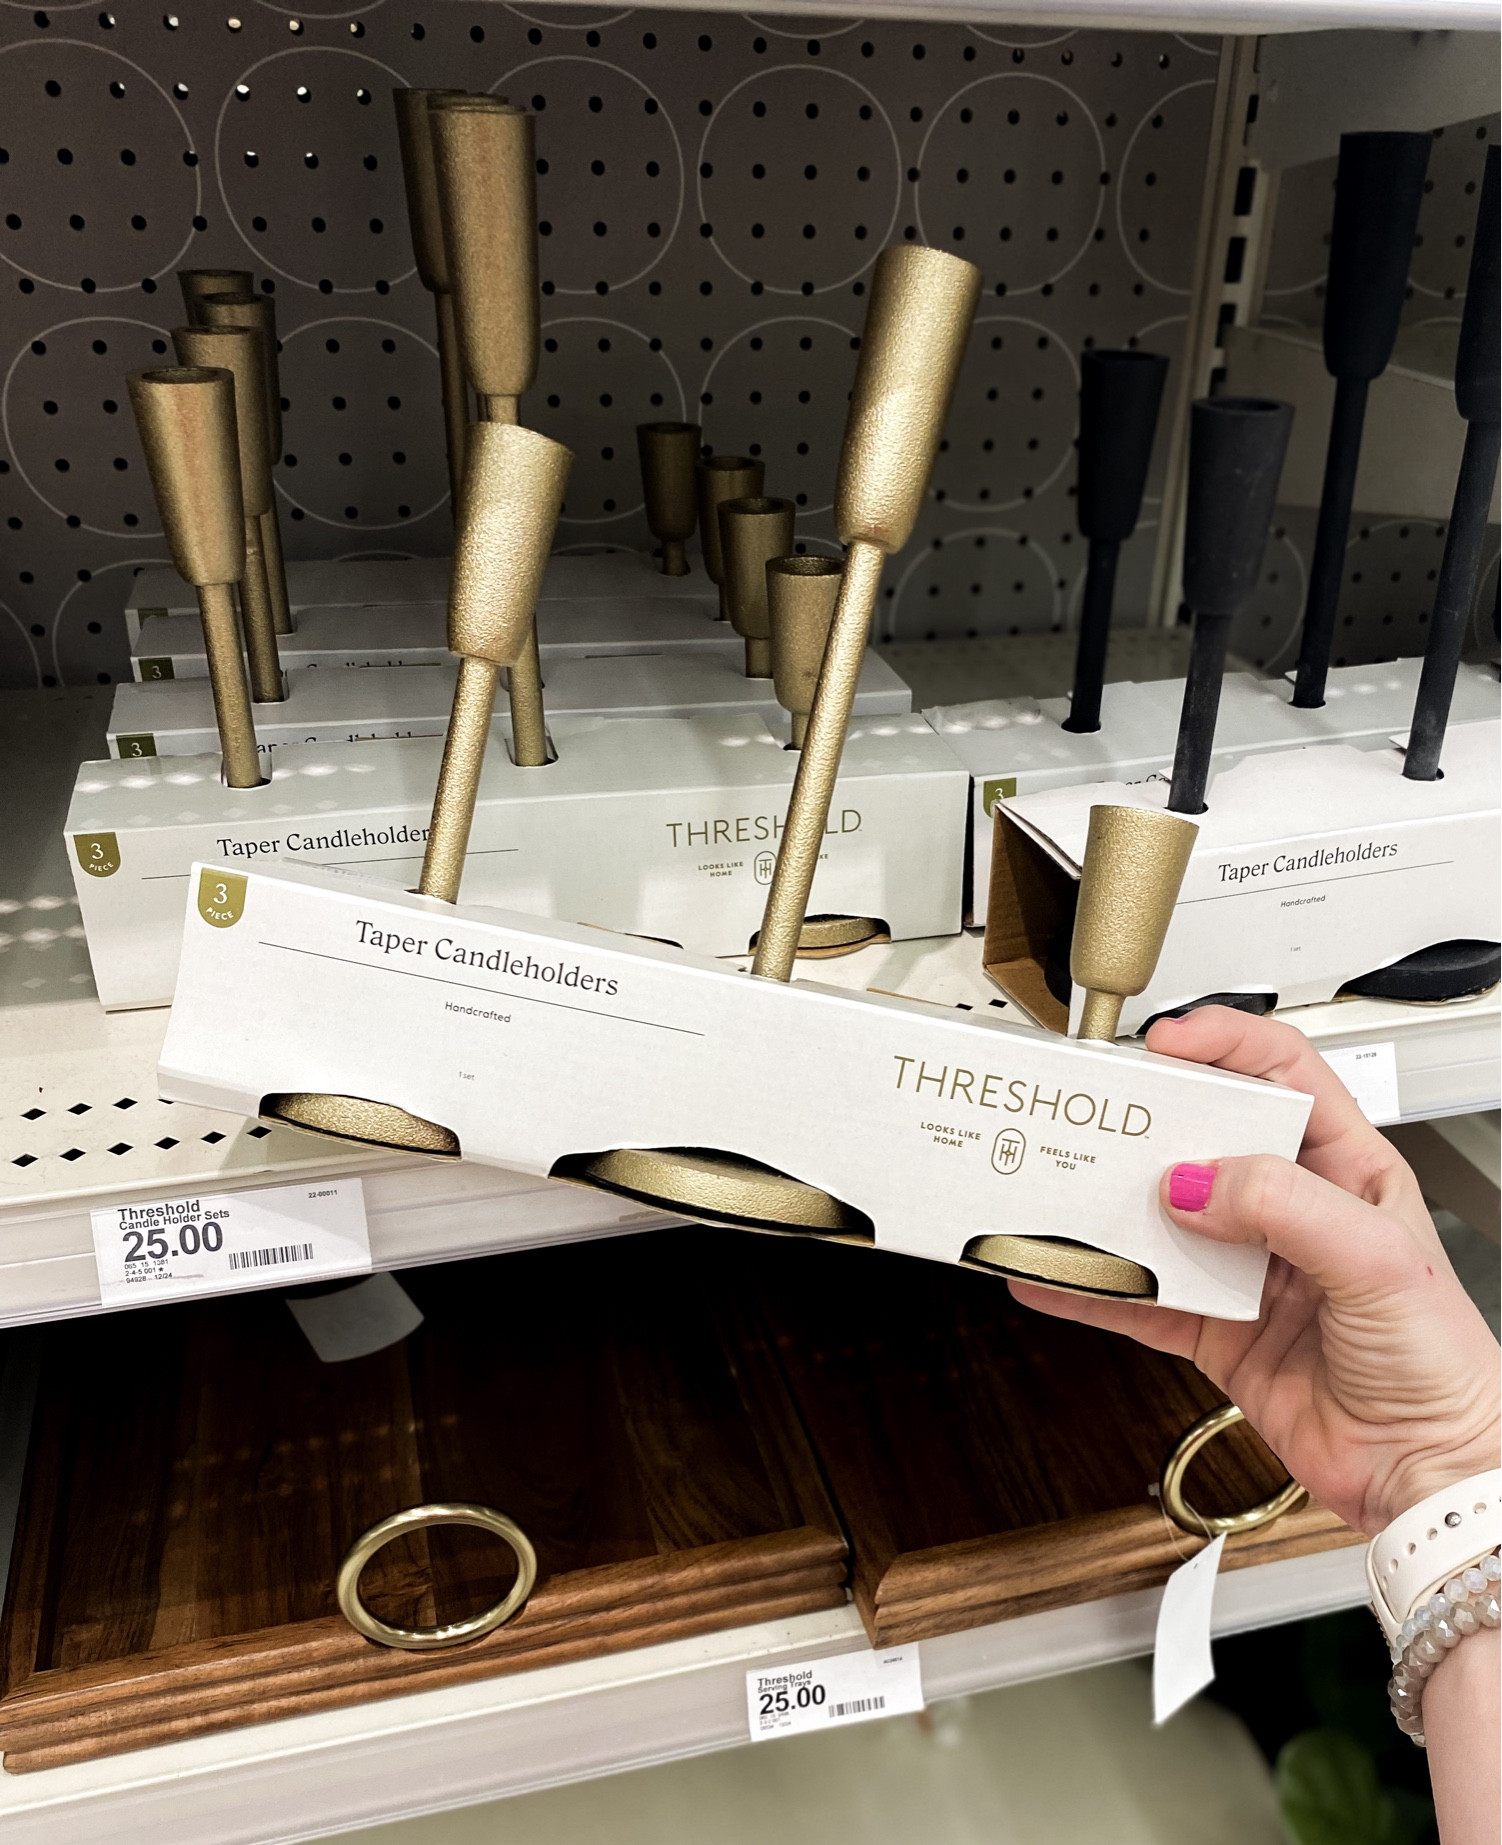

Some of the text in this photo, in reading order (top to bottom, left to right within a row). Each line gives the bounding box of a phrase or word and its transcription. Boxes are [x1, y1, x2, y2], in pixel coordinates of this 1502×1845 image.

[151, 665, 162, 680] 3
[131, 743, 143, 757] 3
[666, 809, 862, 848] THRESHLD
[90, 843, 104, 860] 3
[217, 837, 280, 859] Taper
[88, 860, 115, 873] PIECE
[698, 861, 744, 871] LOOKS LIKE
[1218, 842, 1398, 882] Taper Candleholders
[213, 883, 228, 905] 3
[1280, 895, 1326, 908] Handcrafted
[205, 906, 234, 921] PIECE
[355, 919, 620, 996] Taper Candleholders
[444, 1001, 512, 1023] Handcrafted
[463, 1072, 475, 1081] set
[893, 1055, 1152, 1137] THRESHOLD
[920, 1121, 982, 1141] LOOKS LIKE
[933, 1135, 964, 1148] HOME
[1040, 1145, 1097, 1164] FEELS LIKE
[1055, 1159, 1077, 1171] YOU
[118, 1199, 201, 1221] Threshold
[119, 1209, 230, 1231] Candle Holder Sets
[122, 1221, 224, 1263] 25.00
[757, 1669, 813, 1687] Threshold
[758, 1679, 811, 1694] Serving Trays
[759, 1684, 826, 1716] 25.00
